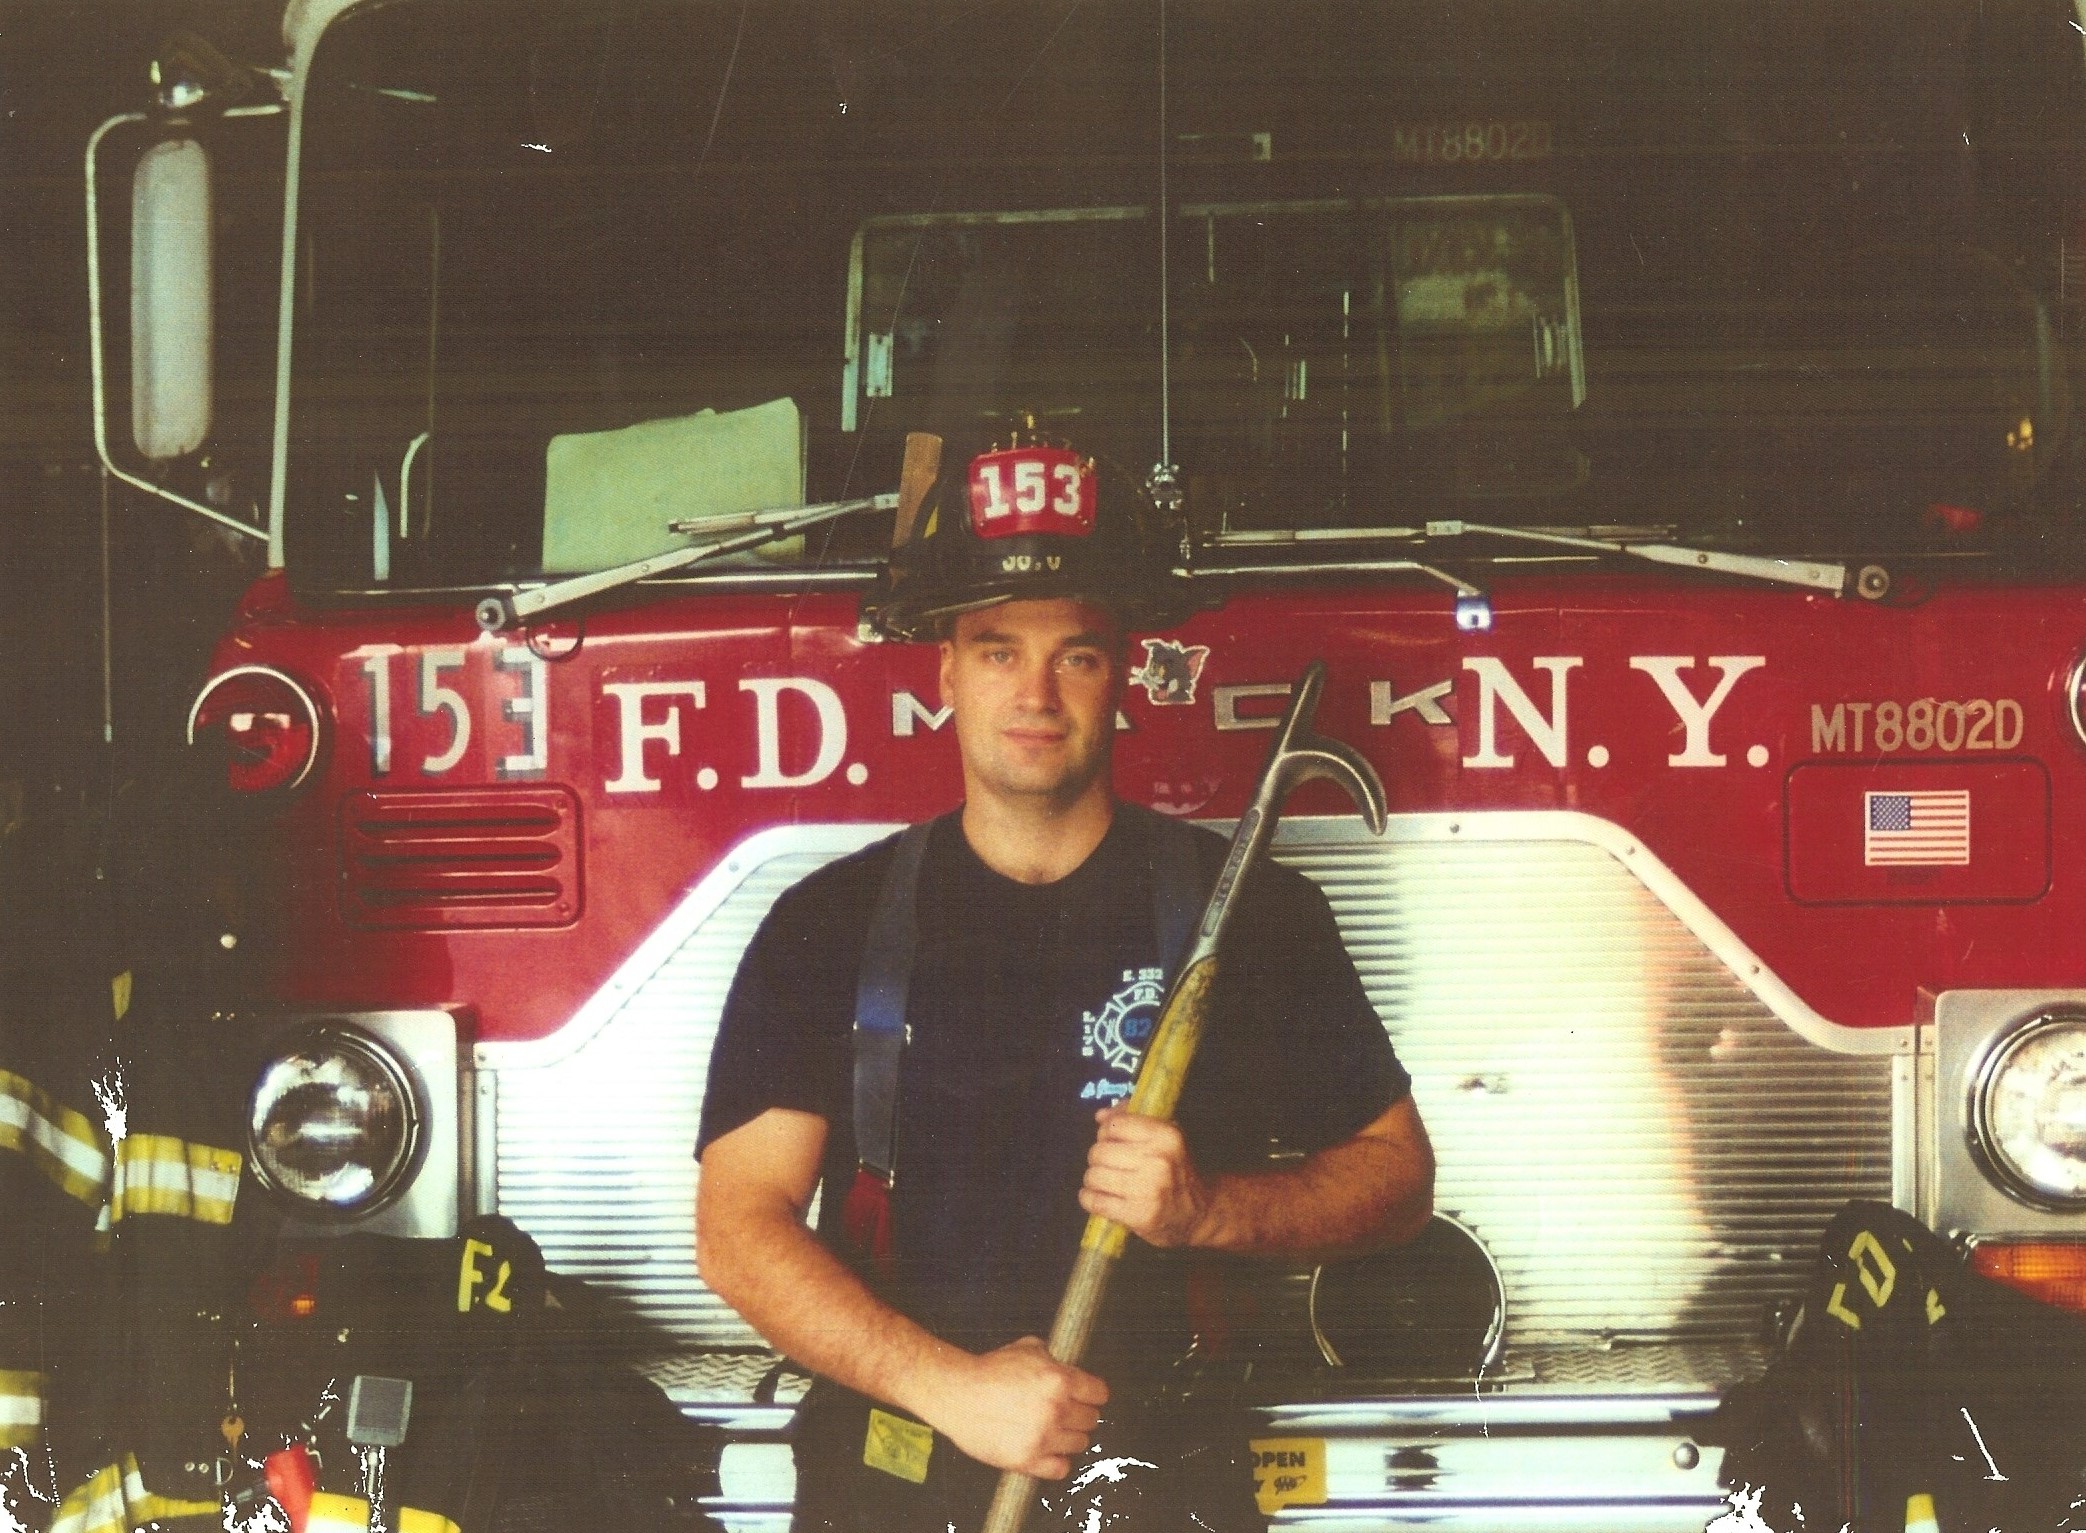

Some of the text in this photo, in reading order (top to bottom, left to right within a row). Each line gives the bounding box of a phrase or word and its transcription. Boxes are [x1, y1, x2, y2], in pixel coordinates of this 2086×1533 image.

[980, 462, 1082, 519] 153
[362, 648, 548, 778] 153
[892, 679, 1453, 737] MCK
[1811, 698, 2025, 755] MT8802D
